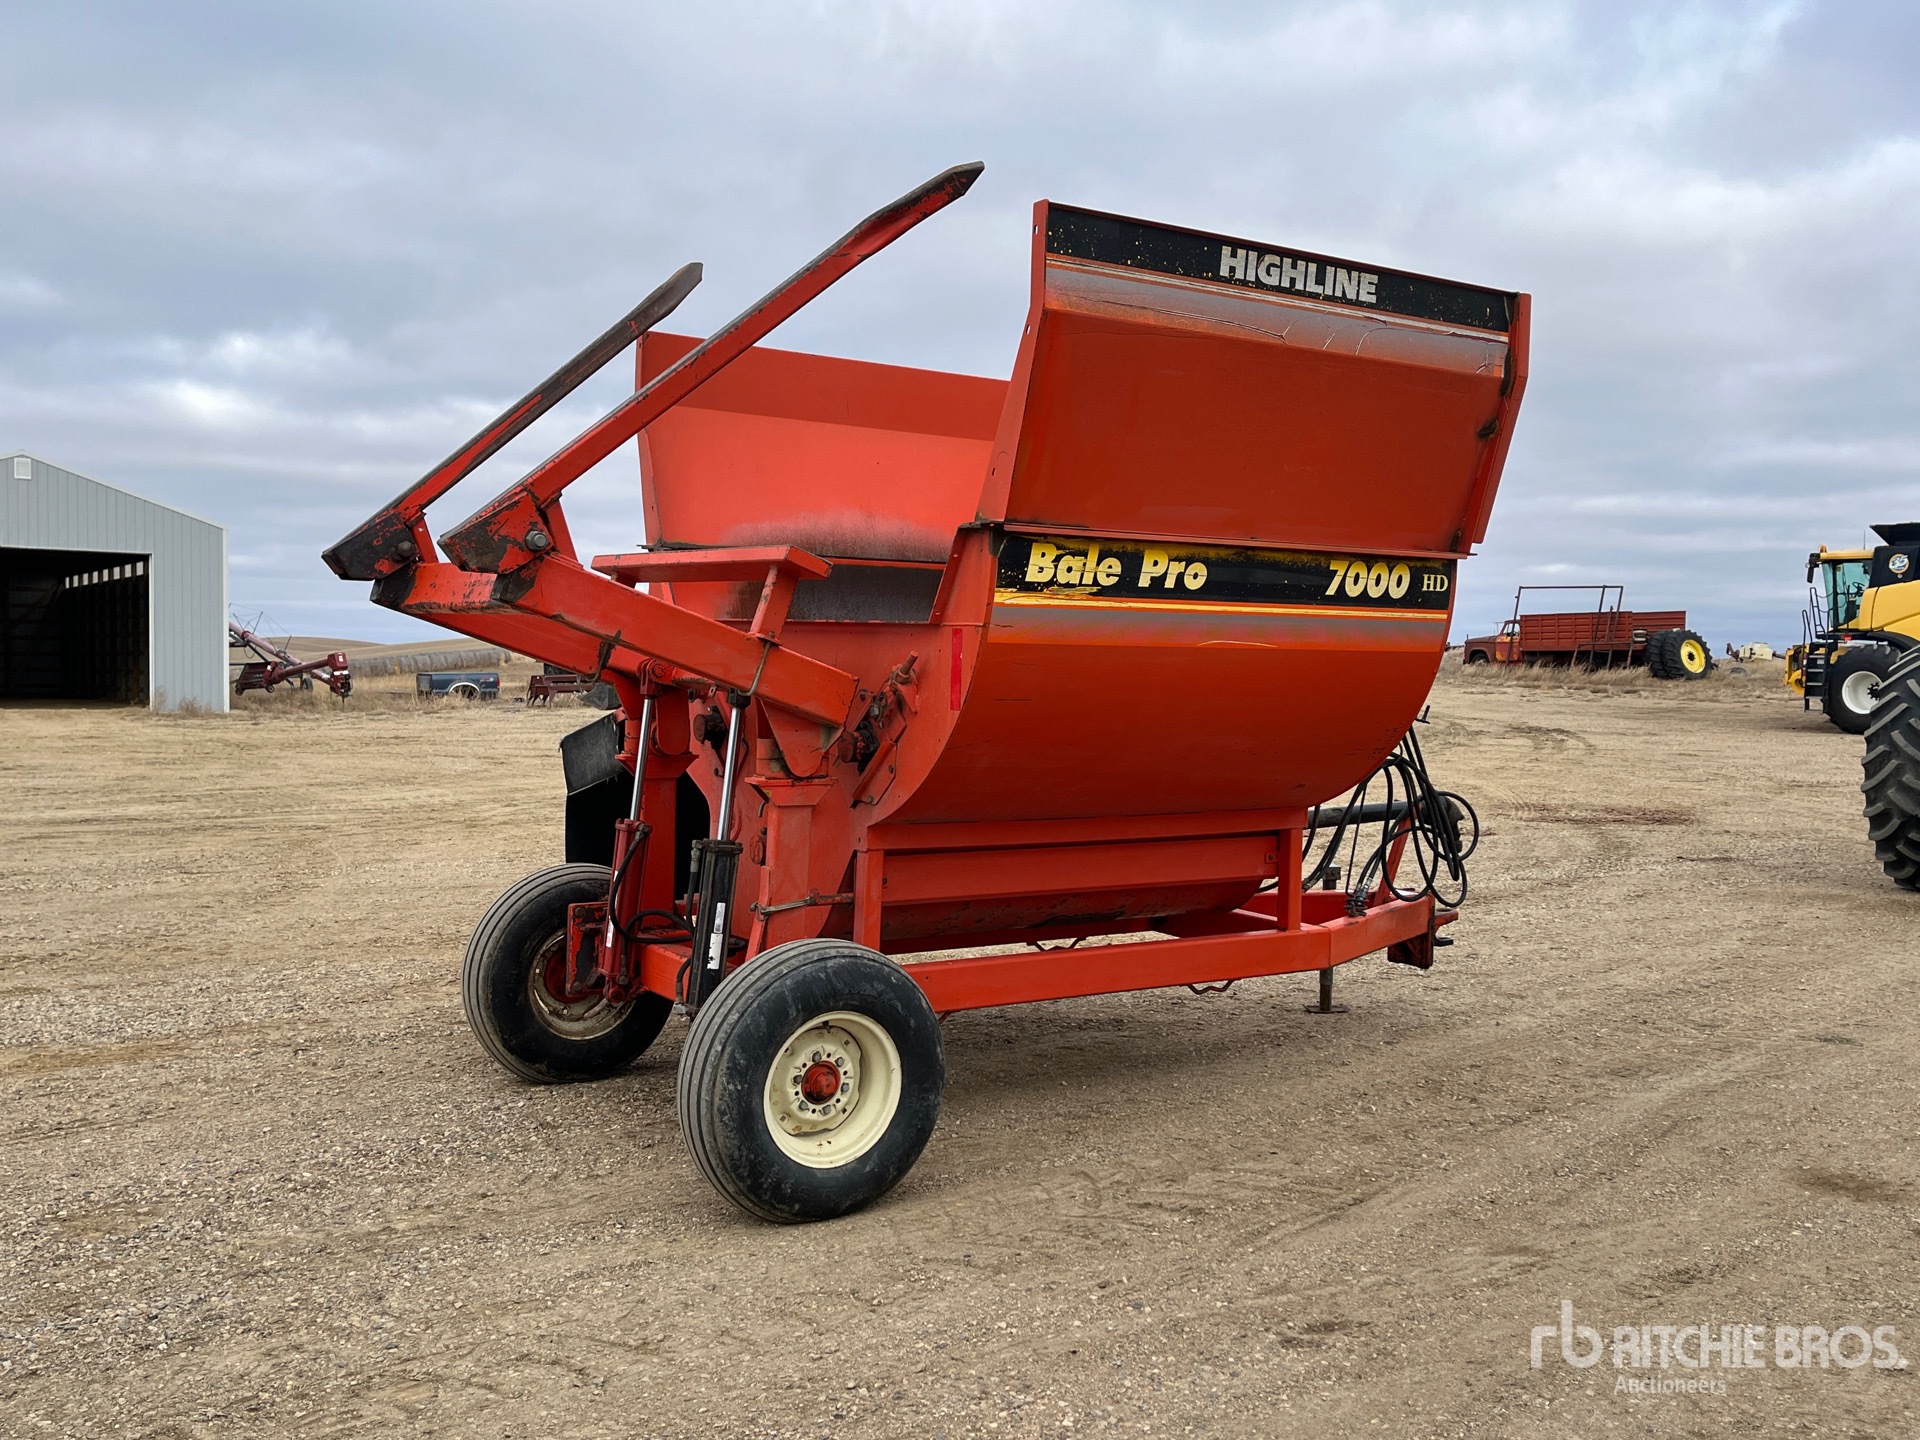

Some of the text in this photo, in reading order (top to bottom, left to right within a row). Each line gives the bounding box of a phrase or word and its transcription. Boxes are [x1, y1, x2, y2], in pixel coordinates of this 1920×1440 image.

[1219, 245, 1379, 303] HIGHLINE
[1025, 542, 1449, 599] Bale Pro 7000 HD
